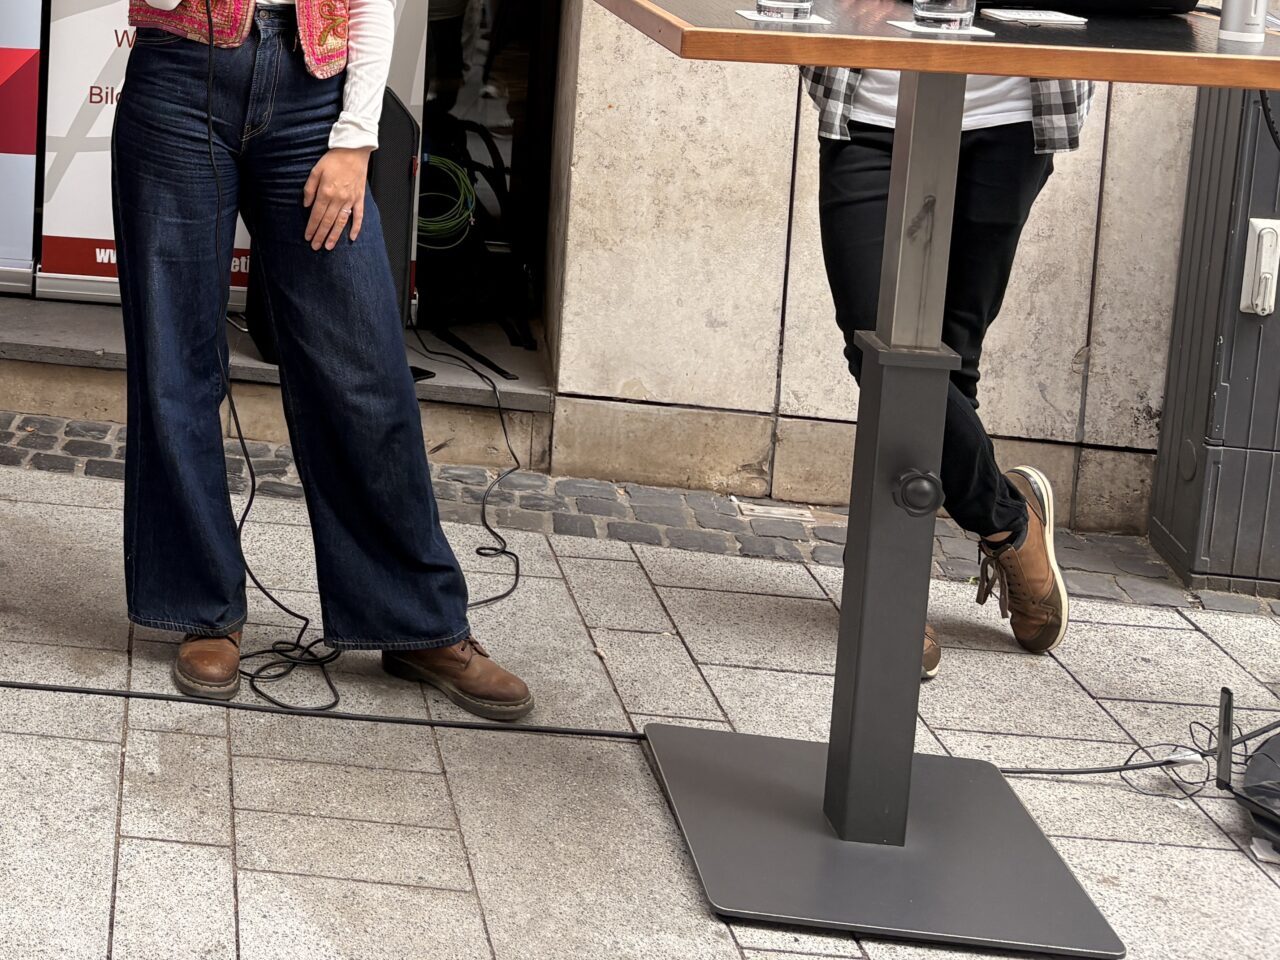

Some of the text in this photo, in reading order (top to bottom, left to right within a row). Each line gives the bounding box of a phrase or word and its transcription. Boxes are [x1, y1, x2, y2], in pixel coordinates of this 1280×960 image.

[114, 29, 136, 48] W
[89, 85, 121, 105] Bil
[230, 255, 250, 273] eti
